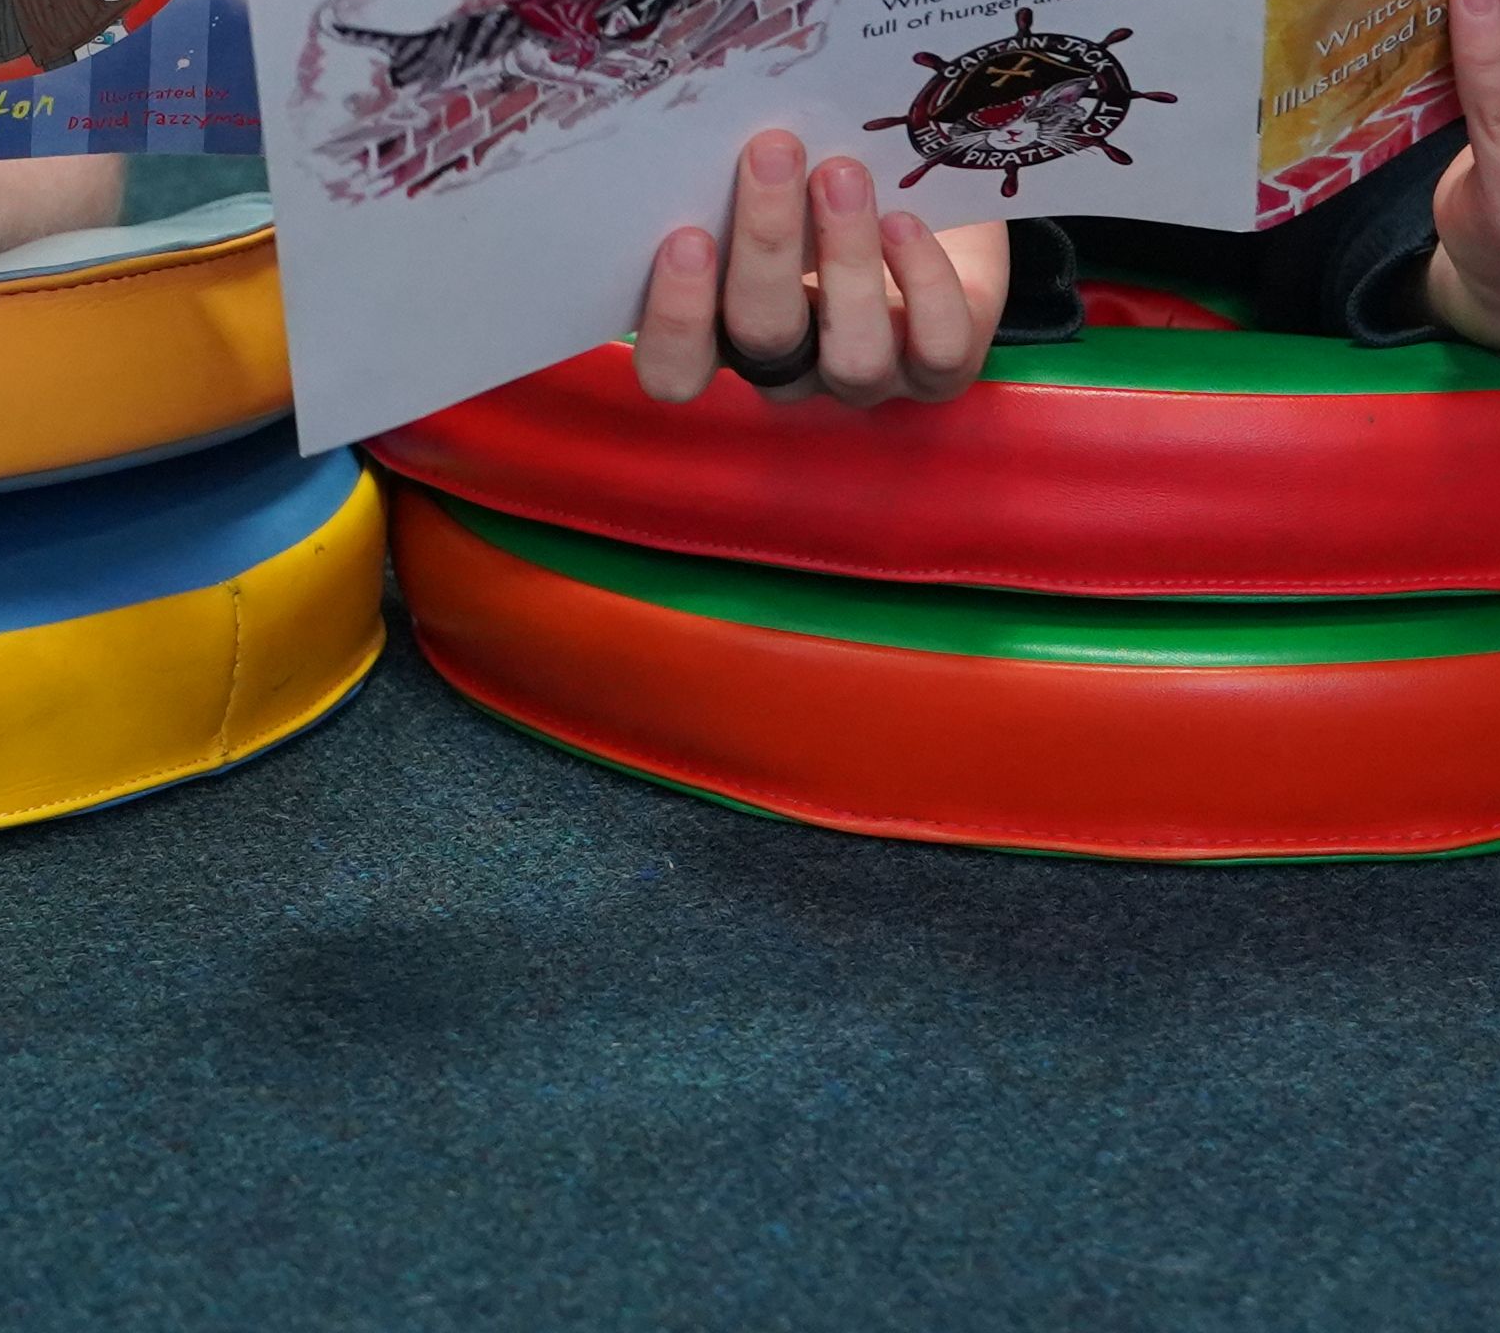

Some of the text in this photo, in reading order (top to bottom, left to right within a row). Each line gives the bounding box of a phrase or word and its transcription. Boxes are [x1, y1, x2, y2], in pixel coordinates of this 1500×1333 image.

[862, 19, 898, 39] full
[908, 11, 934, 30] of
[944, 35, 1114, 79] CAPTAIN JACK
[1272, 20, 1416, 118] Illustrated
[204, 84, 230, 103] by
[66, 114, 130, 132] David
[913, 101, 1125, 167] THE PIRATE CAT
